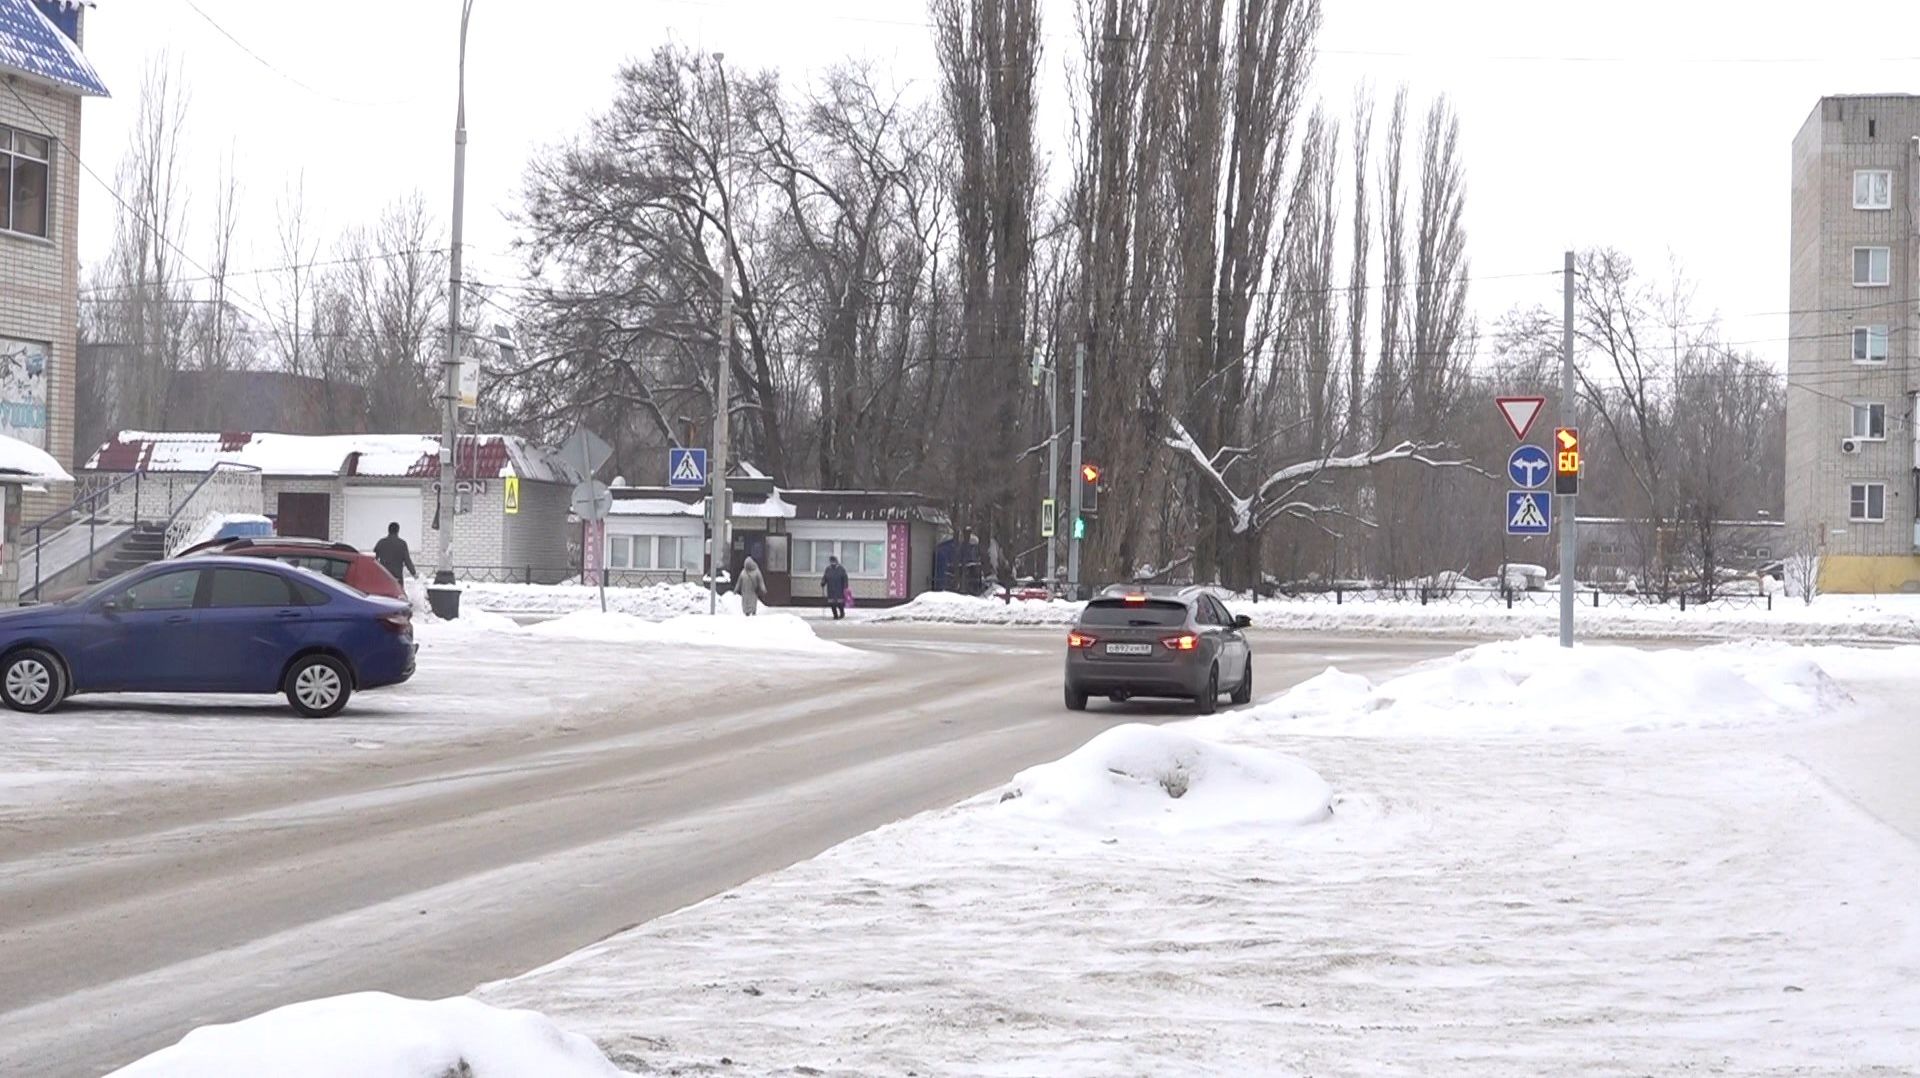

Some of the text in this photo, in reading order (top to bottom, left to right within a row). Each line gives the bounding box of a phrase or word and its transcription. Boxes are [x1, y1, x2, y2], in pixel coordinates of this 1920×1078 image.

[1559, 452, 1578, 471] 60
[431, 481, 486, 495] OON
[889, 524, 897, 596] ТРИКОТАЖ
